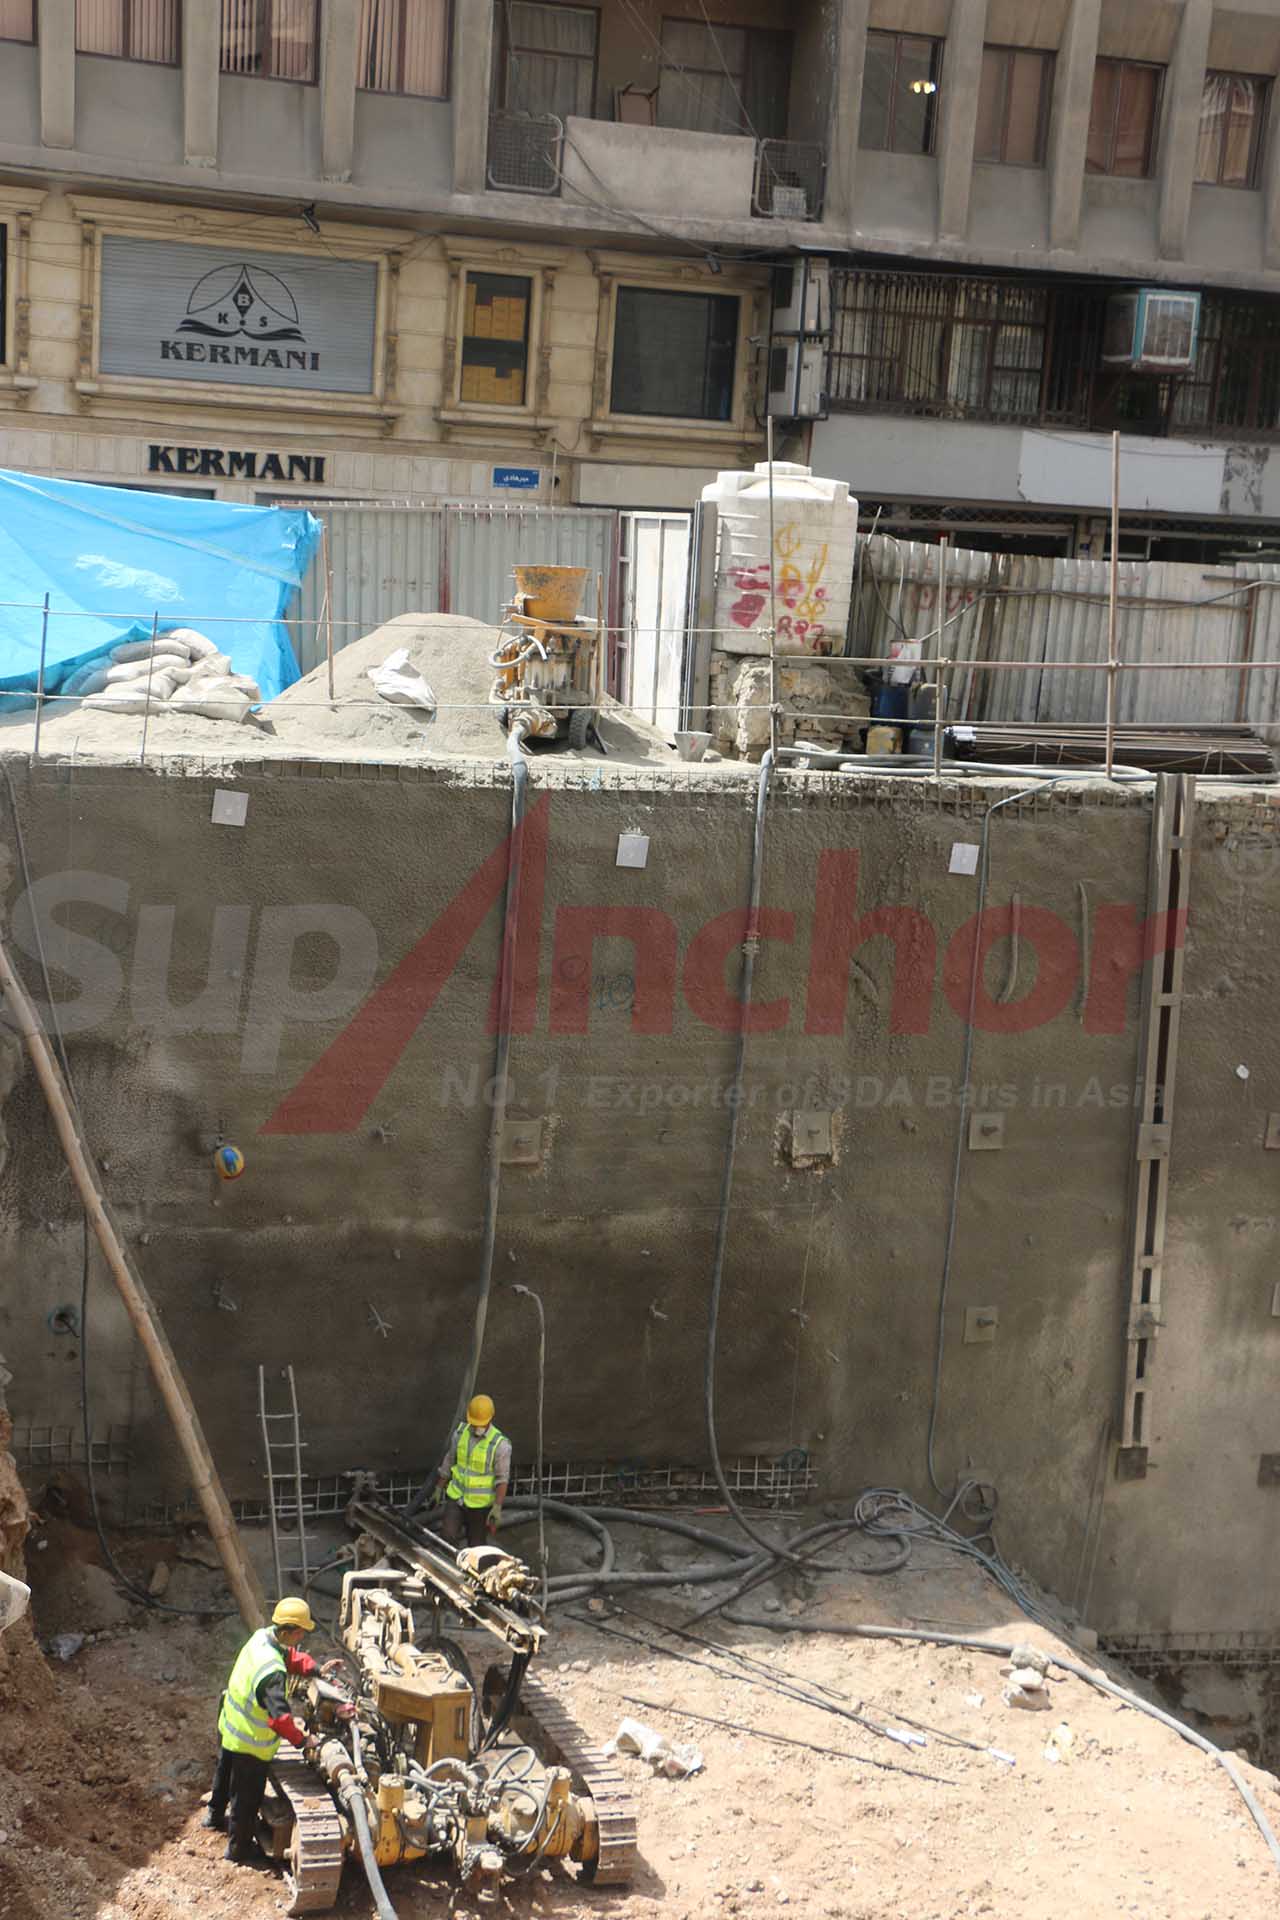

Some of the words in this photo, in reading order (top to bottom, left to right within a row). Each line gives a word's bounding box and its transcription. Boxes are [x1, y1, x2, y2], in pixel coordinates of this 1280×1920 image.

[237, 294, 250, 306] B
[218, 312, 229, 324] K
[259, 316, 268, 327] S
[160, 340, 320, 371] KERMANI
[148, 445, 326, 483] KERMANI
